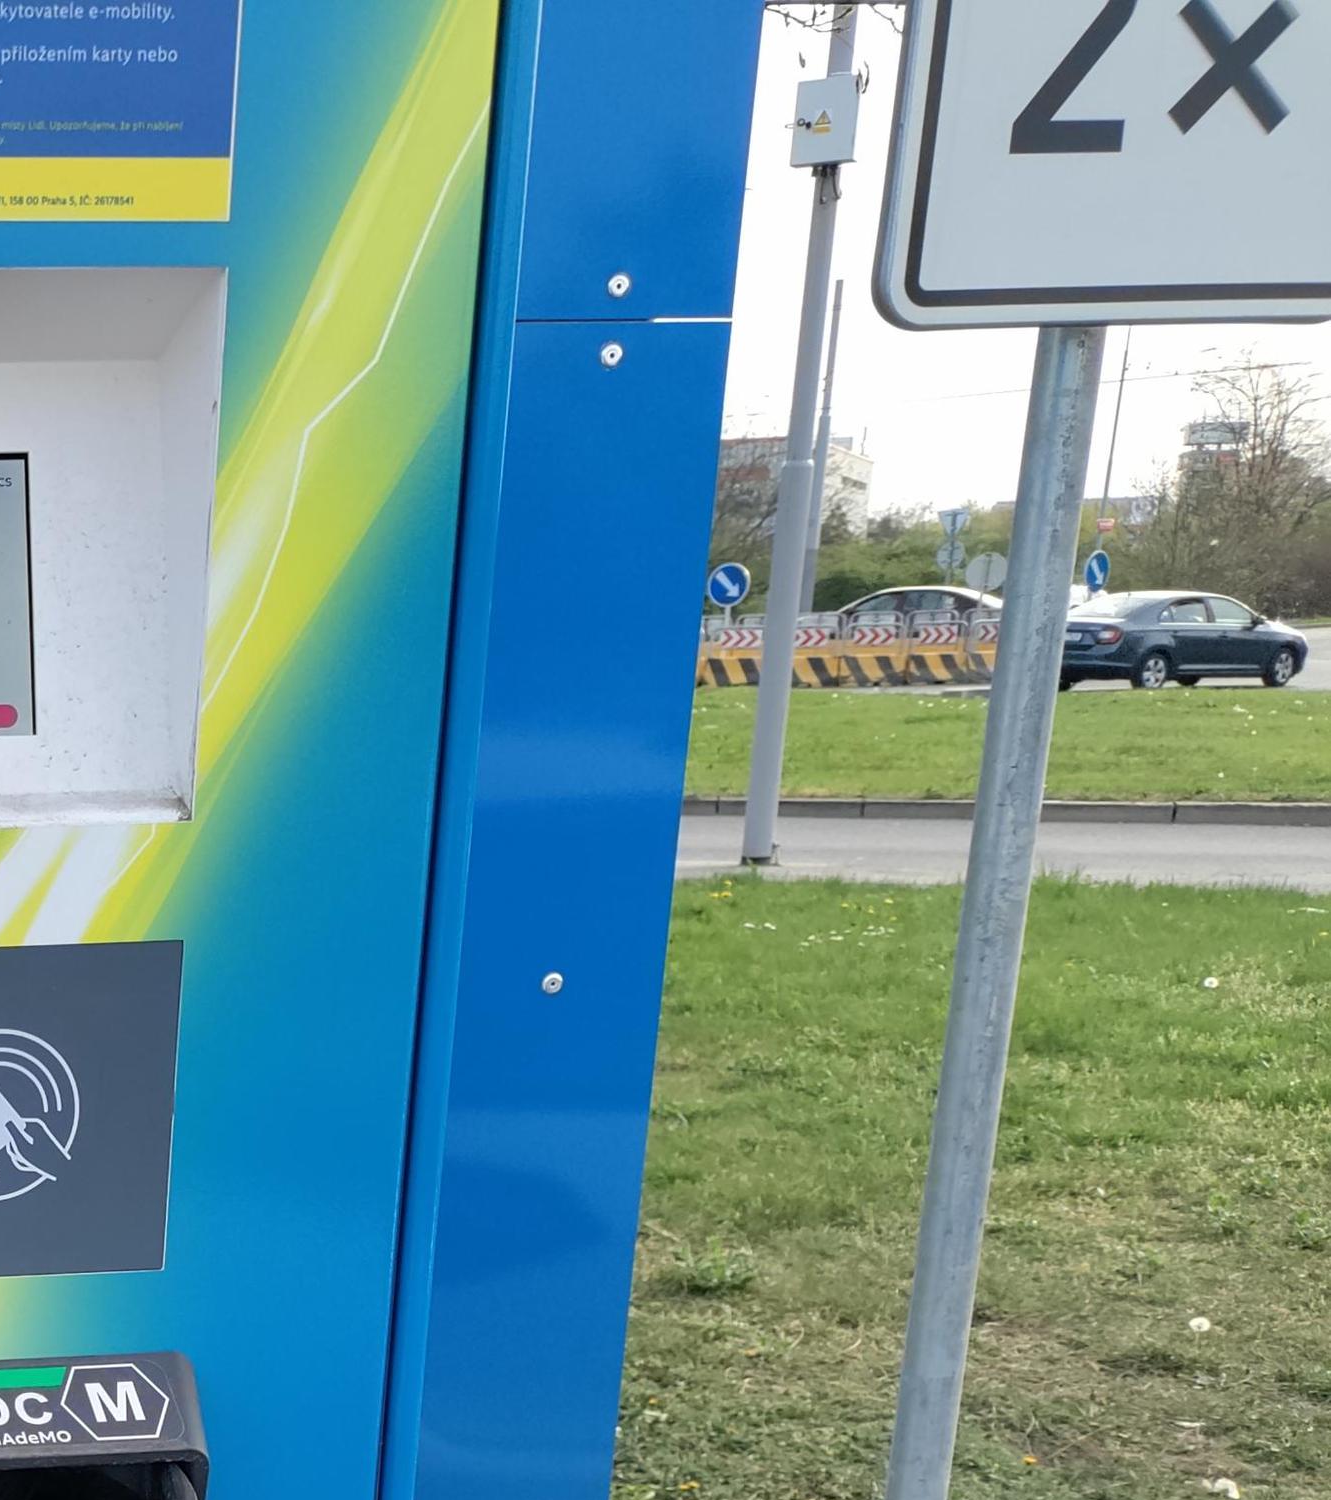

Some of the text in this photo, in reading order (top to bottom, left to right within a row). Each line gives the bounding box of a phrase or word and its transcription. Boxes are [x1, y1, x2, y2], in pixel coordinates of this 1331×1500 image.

[89, 1, 175, 23] e-mobility.
[1, 45, 87, 65] přiložením
[92, 45, 132, 66] karty
[137, 45, 178, 62] nebo
[41, 195, 67, 206] Praha
[84, 1380, 147, 1423] M
